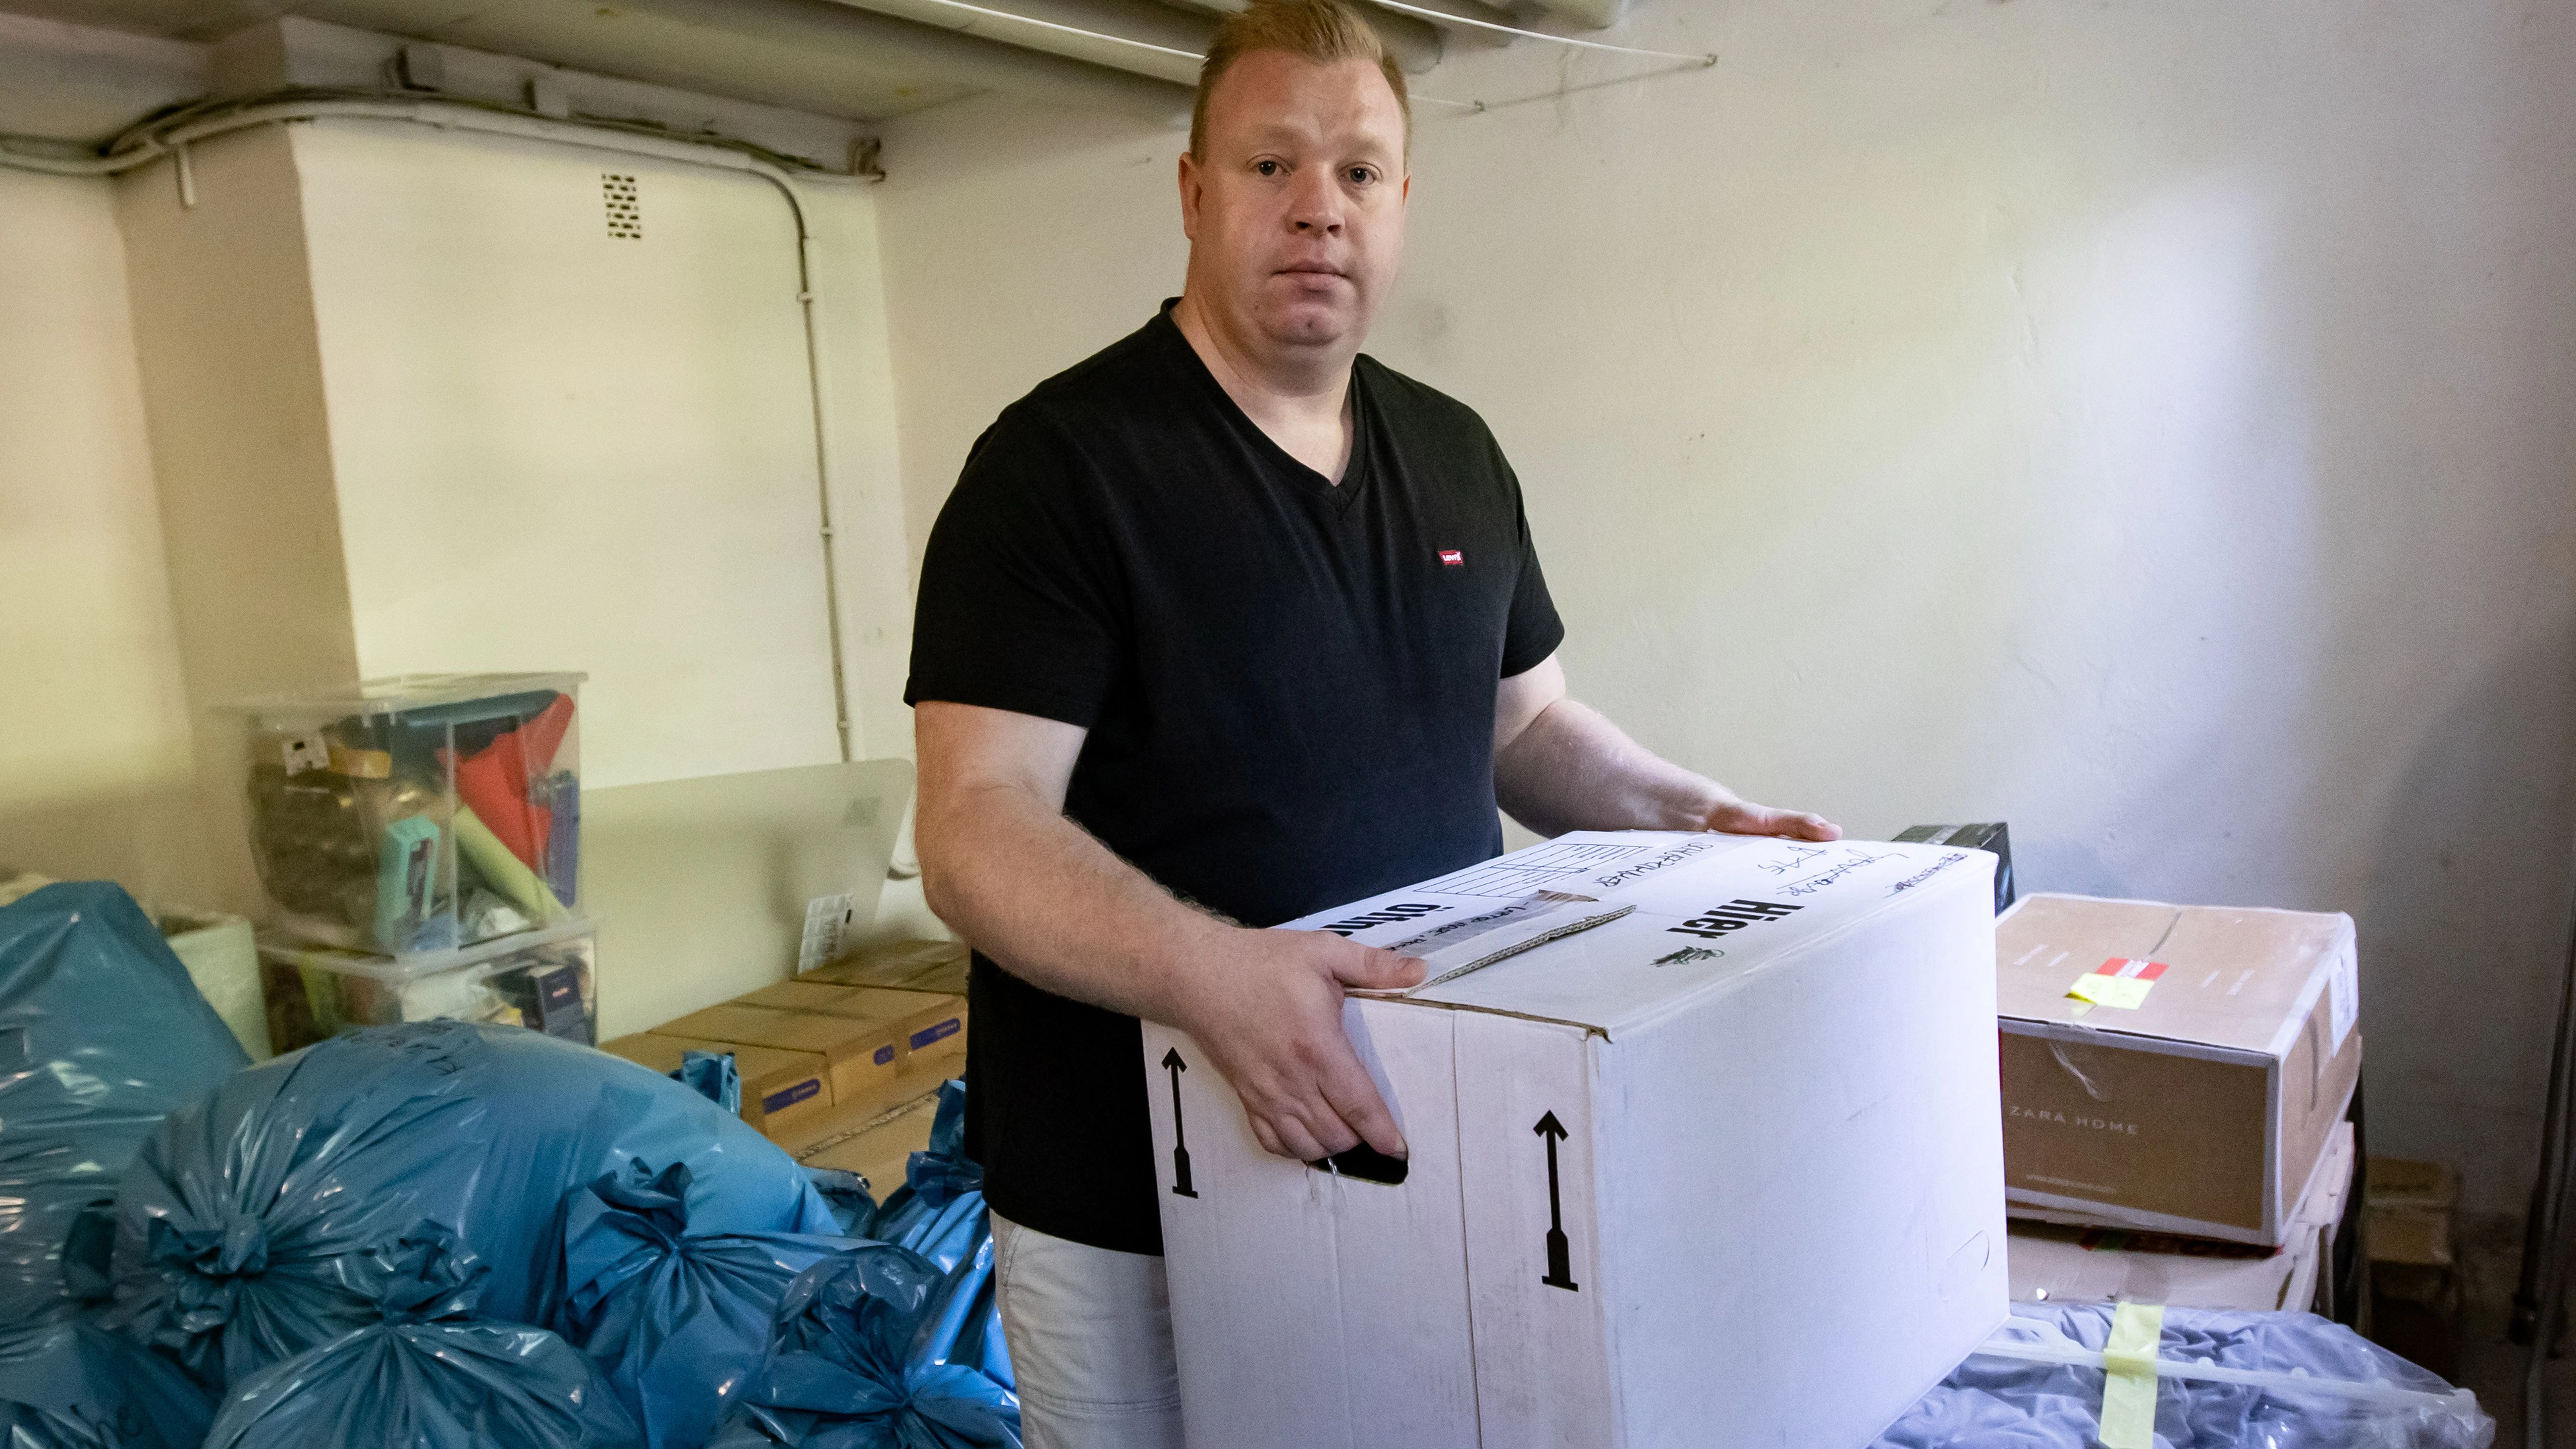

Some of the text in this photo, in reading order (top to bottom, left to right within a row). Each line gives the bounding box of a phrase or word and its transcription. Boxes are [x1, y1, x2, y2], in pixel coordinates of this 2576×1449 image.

[1664, 899, 1805, 939] Hier
[2010, 1106, 2138, 1135] ZARA HOME
